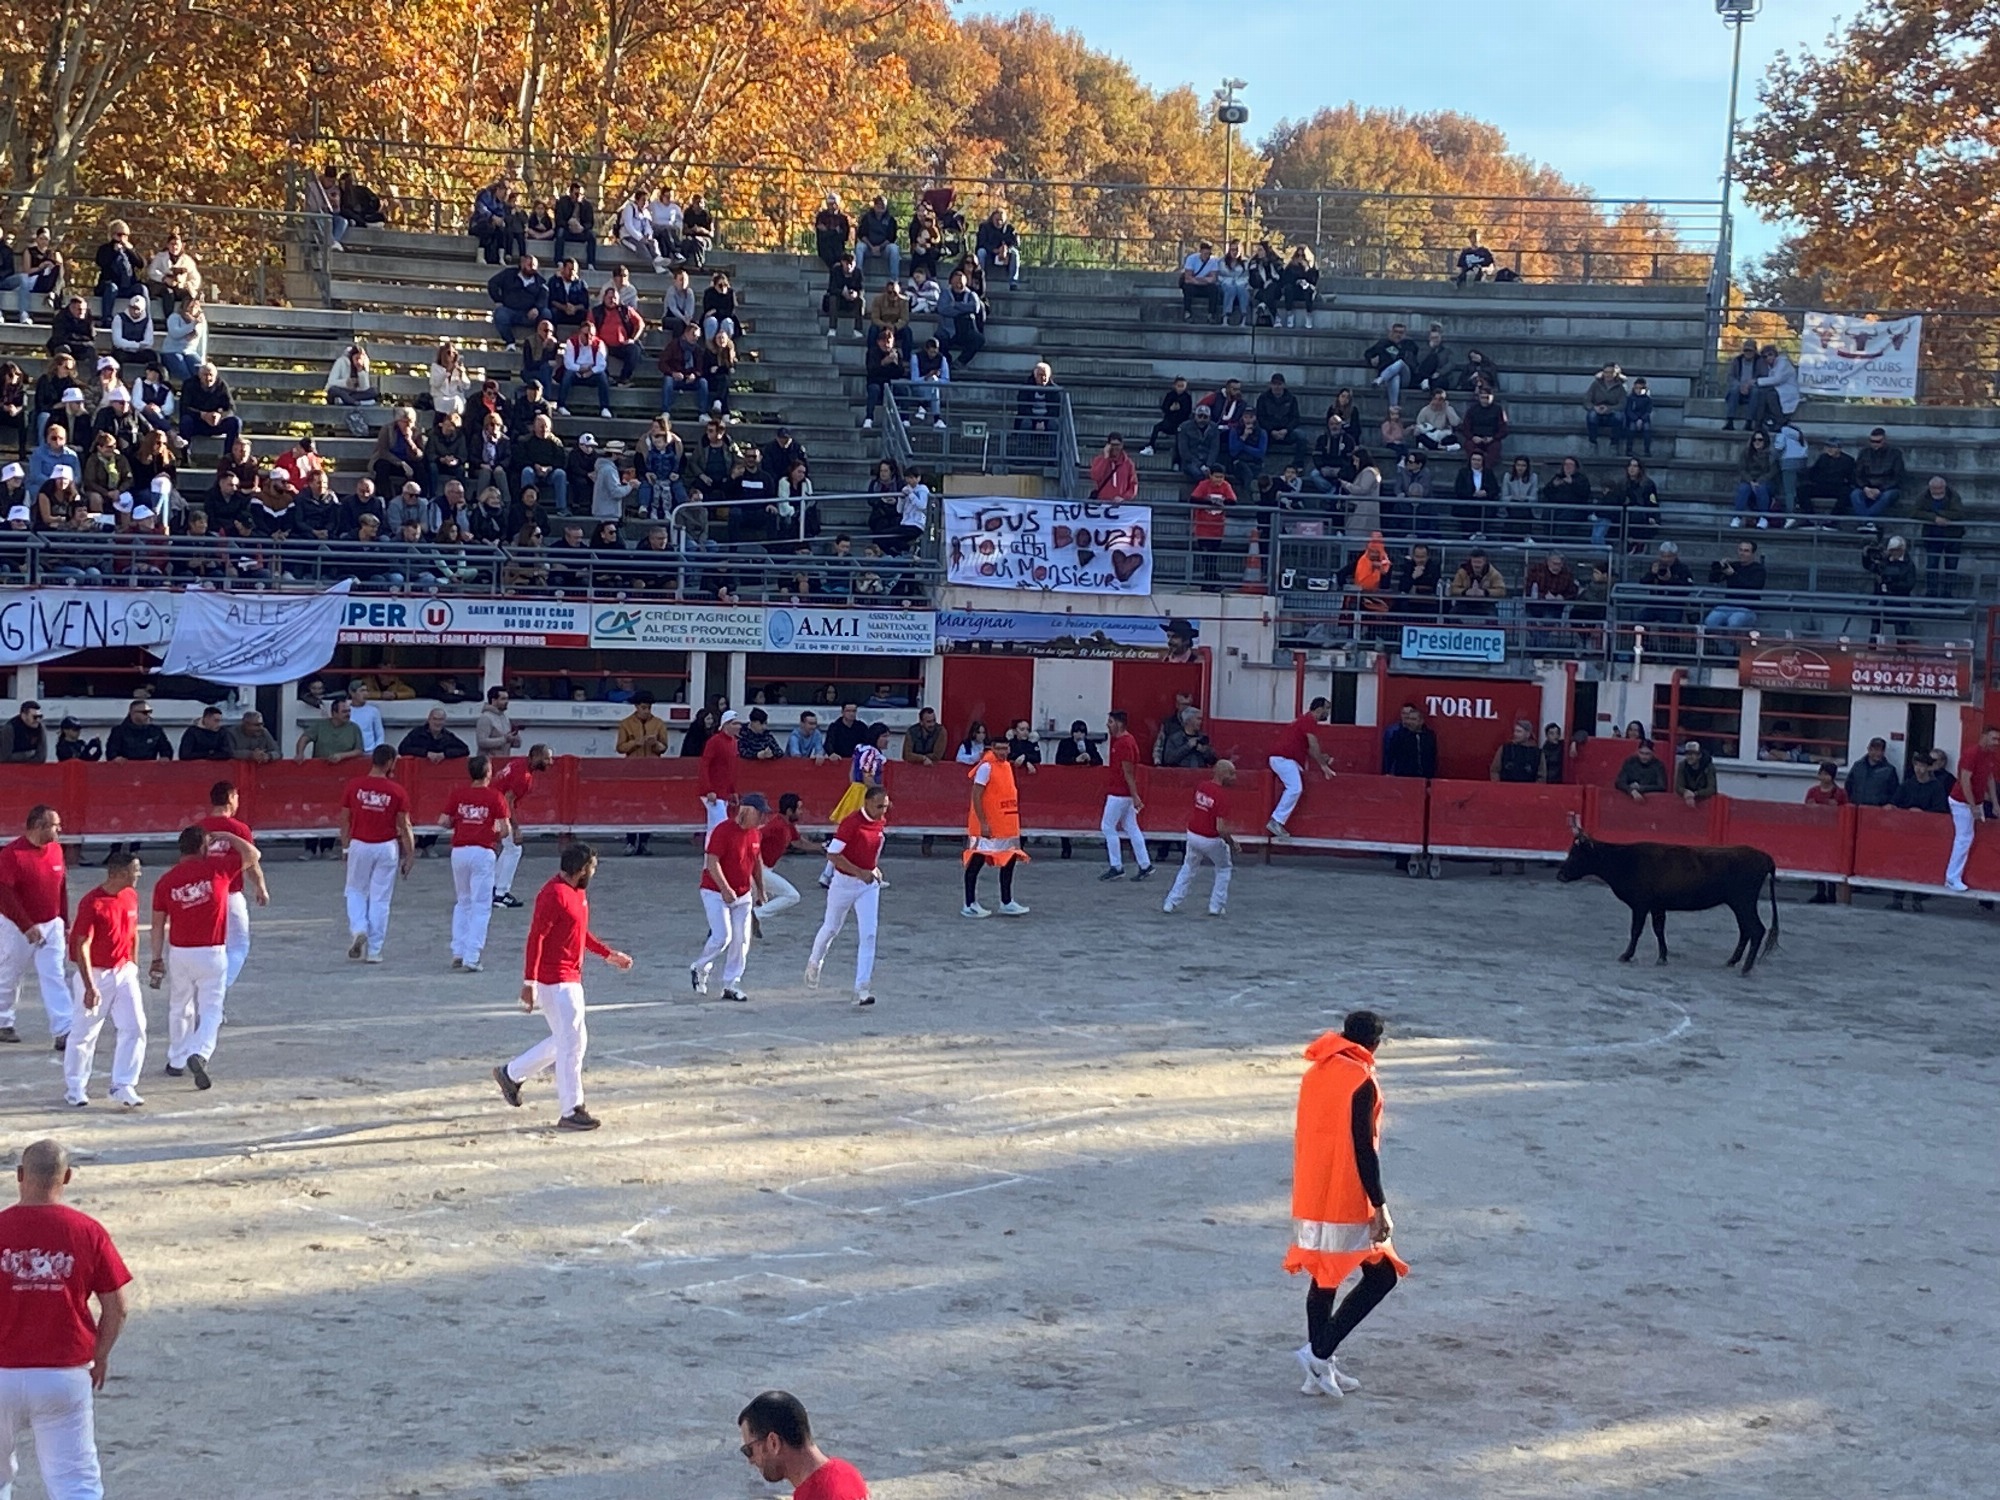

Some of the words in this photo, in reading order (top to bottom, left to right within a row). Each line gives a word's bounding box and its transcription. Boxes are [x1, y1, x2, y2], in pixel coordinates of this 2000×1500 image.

[1814, 361, 1853, 371] UNION
[1863, 361, 1902, 373] CLUBS
[1801, 373, 1850, 386] TAURINS
[1866, 376, 1913, 388] FRANCE
[340, 603, 406, 627] PER
[427, 608, 445, 626] U
[467, 605, 494, 615] SAINT
[497, 606, 533, 616] MARTIN
[535, 607, 546, 617] DE
[549, 608, 575, 618] CRAU
[644, 609, 696, 622] CRÉDIT
[695, 612, 763, 624] AGRICOLE
[867, 612, 916, 621] ASSISTANCE
[504, 619, 516, 628] 04
[519, 619, 531, 629] 90
[534, 620, 544, 629] 47
[546, 620, 559, 630] 23
[796, 616, 860, 637] A.M.I
[867, 622, 929, 631] MAINTENANCE
[936, 612, 1016, 635] Marignan
[643, 624, 688, 634] ALPES
[691, 625, 763, 637] PROVENCE
[866, 632, 932, 641] INFORMATIQUE
[699, 637, 763, 646] ASSURANCES
[1406, 628, 1501, 651] Présidence
[1089, 648, 1123, 658] Martin
[1752, 667, 1778, 676] ACTION
[1853, 661, 1879, 670] Saint
[1880, 662, 1915, 672] Martin
[1751, 679, 1829, 689] INTERNATIONALE
[1852, 670, 1870, 683] 04
[1873, 671, 1893, 684] 90
[1895, 672, 1914, 685] 47
[1917, 673, 1936, 687] 38
[1938, 674, 1957, 687] 94
[1851, 684, 1959, 697] www.actionim.net
[1425, 695, 1498, 719] TORIL
